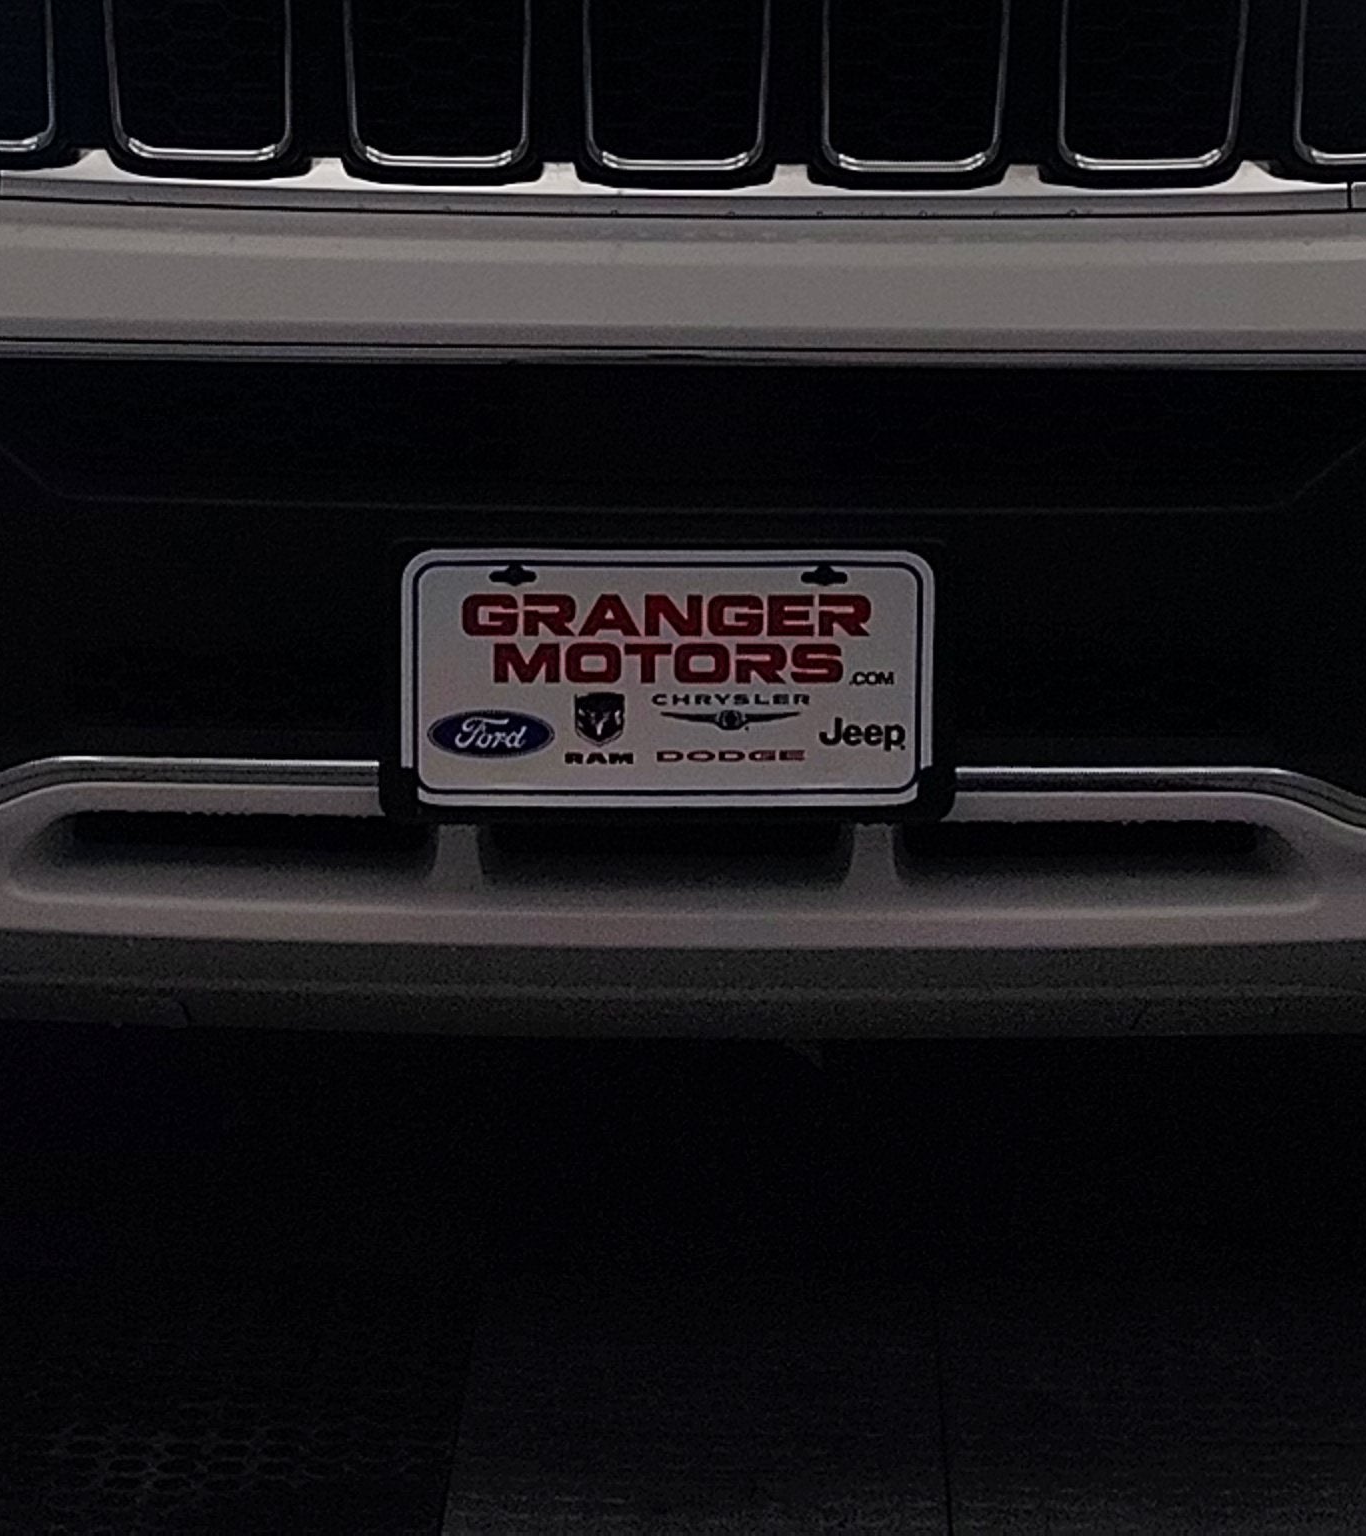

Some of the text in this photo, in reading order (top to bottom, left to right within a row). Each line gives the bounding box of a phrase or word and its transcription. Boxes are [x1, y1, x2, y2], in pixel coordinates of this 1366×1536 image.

[461, 593, 872, 637] GRANGER
[492, 642, 895, 686] MOTORS .COM
[651, 693, 811, 706] CHRYSLER
[454, 716, 527, 750] Ford
[819, 717, 905, 751] Jeep
[564, 751, 635, 765] RAM
[655, 749, 805, 763] DODGE
